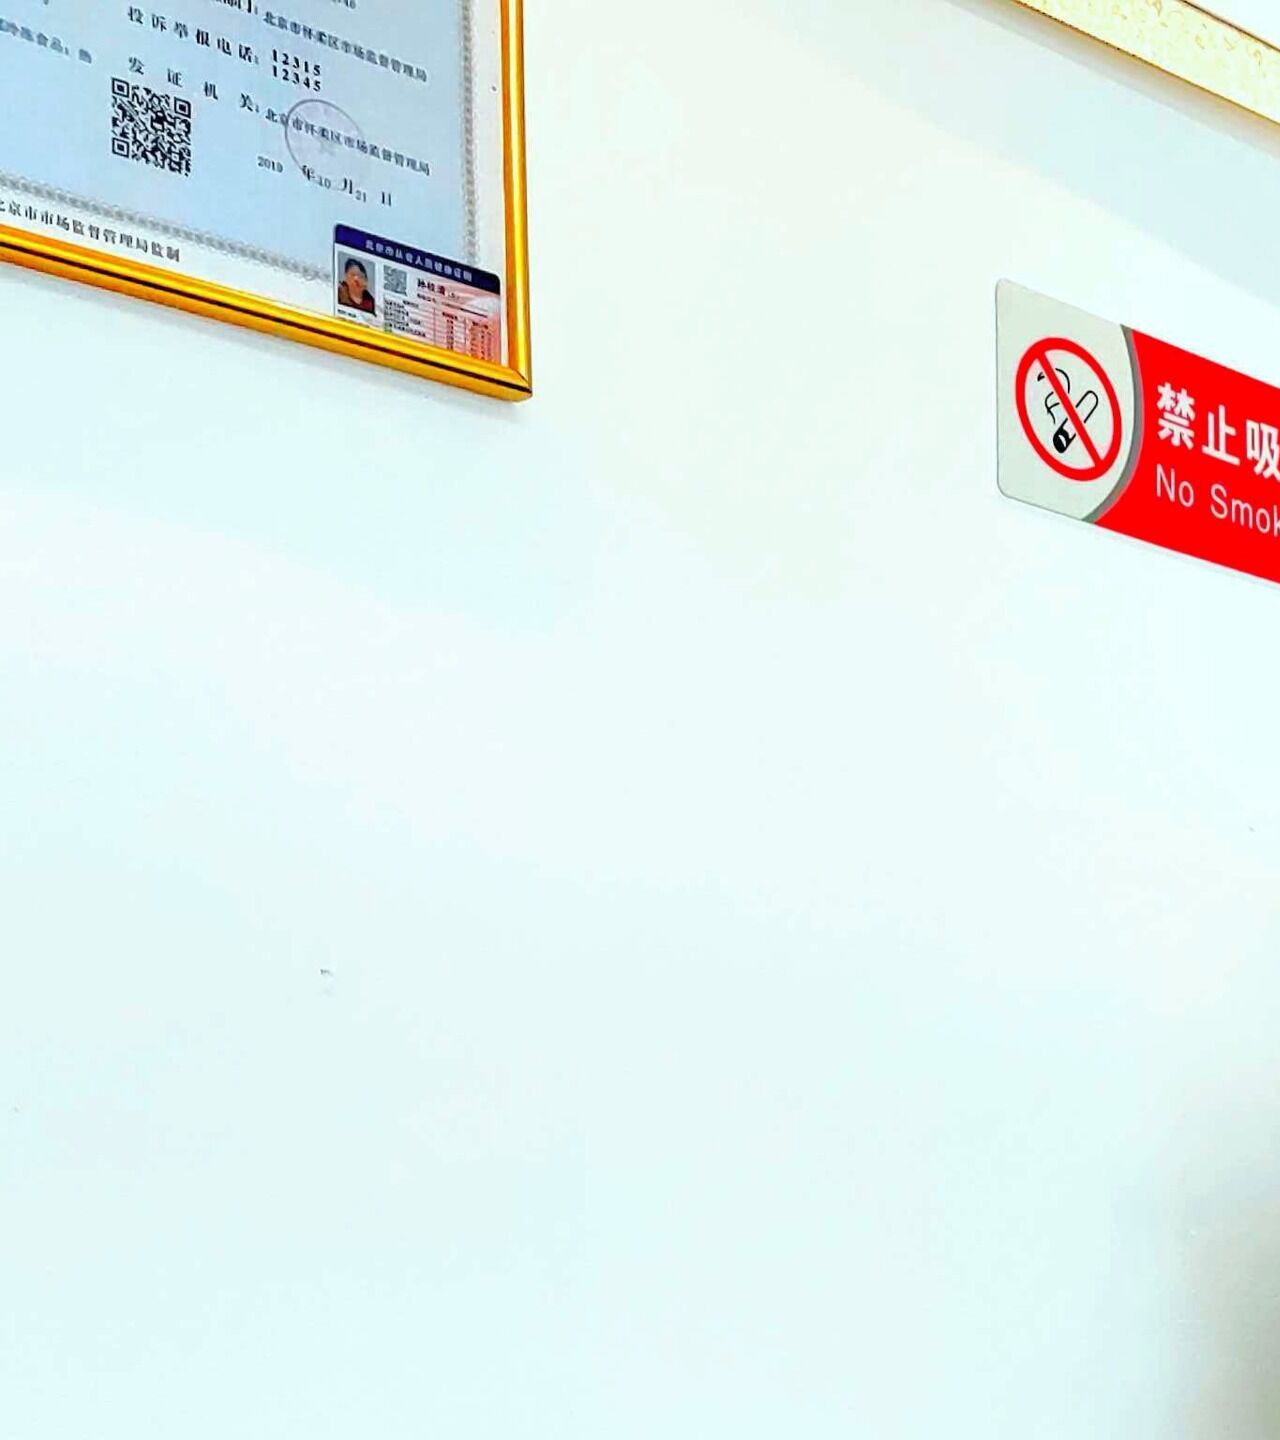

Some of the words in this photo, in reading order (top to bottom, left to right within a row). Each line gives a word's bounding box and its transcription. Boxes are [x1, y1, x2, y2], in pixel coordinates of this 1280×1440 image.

[272, 49, 321, 76] 12315
[272, 65, 321, 92] 12345
[1156, 464, 1195, 507] No
